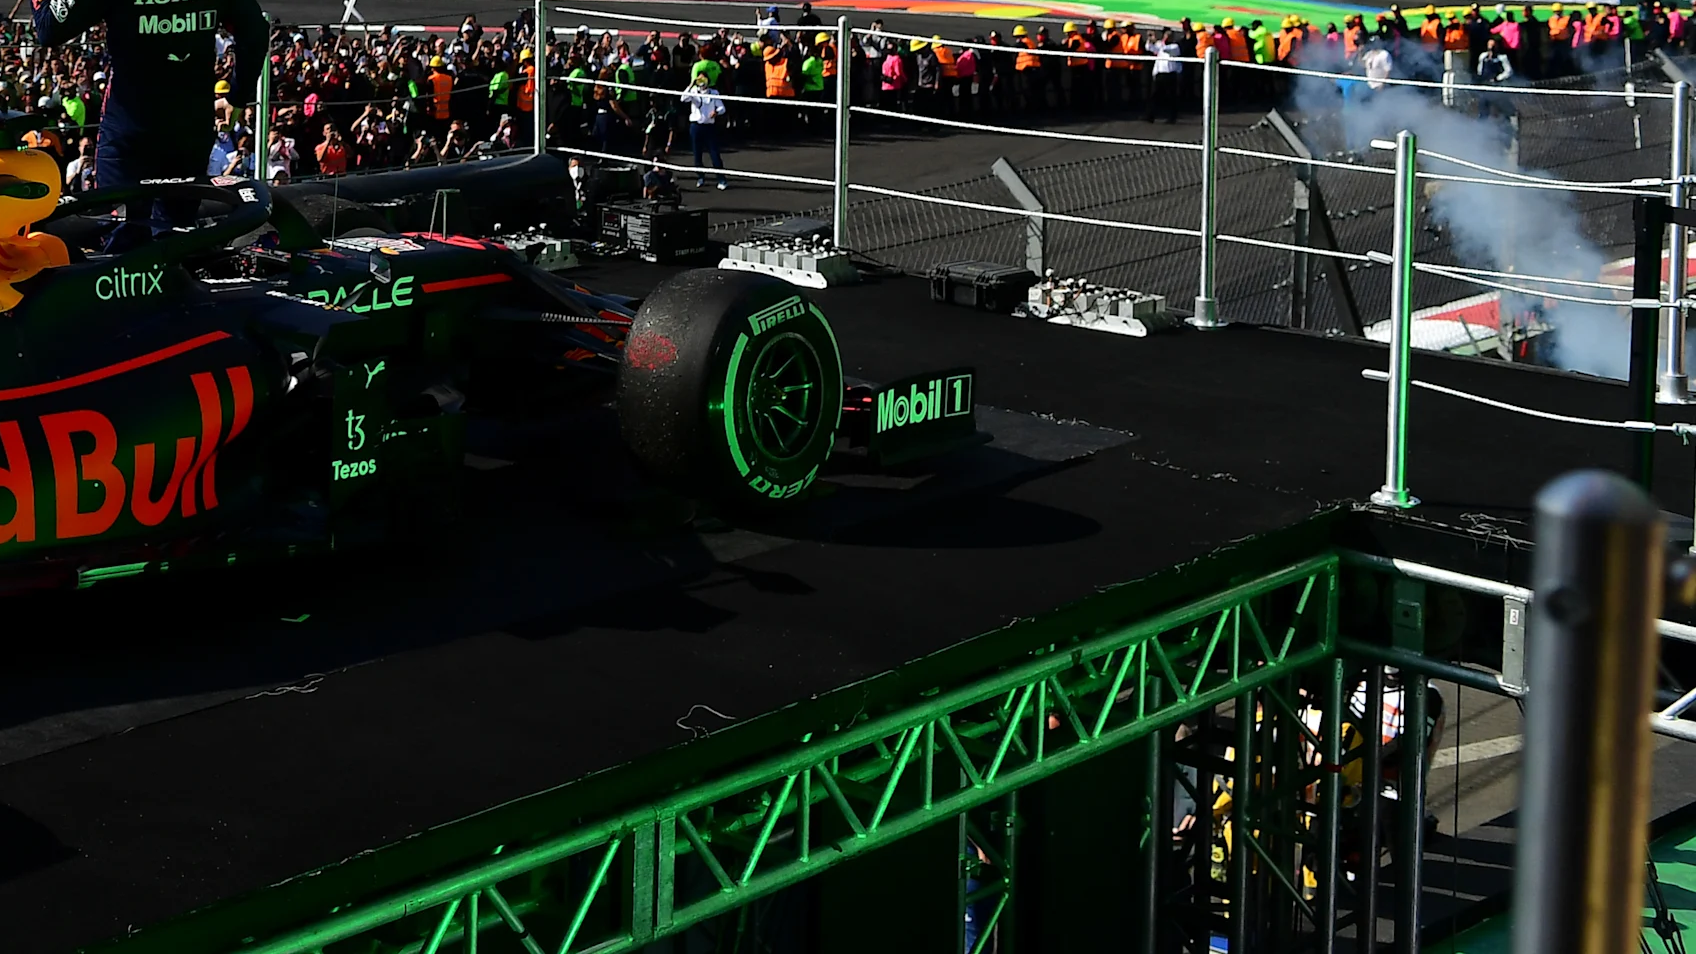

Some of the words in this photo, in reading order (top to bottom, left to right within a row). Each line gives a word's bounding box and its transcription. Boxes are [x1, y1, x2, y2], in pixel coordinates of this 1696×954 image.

[138, 12, 196, 34] Mobil
[95, 264, 166, 300] citrix
[748, 295, 805, 336] PIRELLI
[877, 379, 942, 433] Mobil
[39, 366, 254, 539] Bull
[332, 458, 377, 480] Tezos
[749, 464, 819, 499] ZERO
